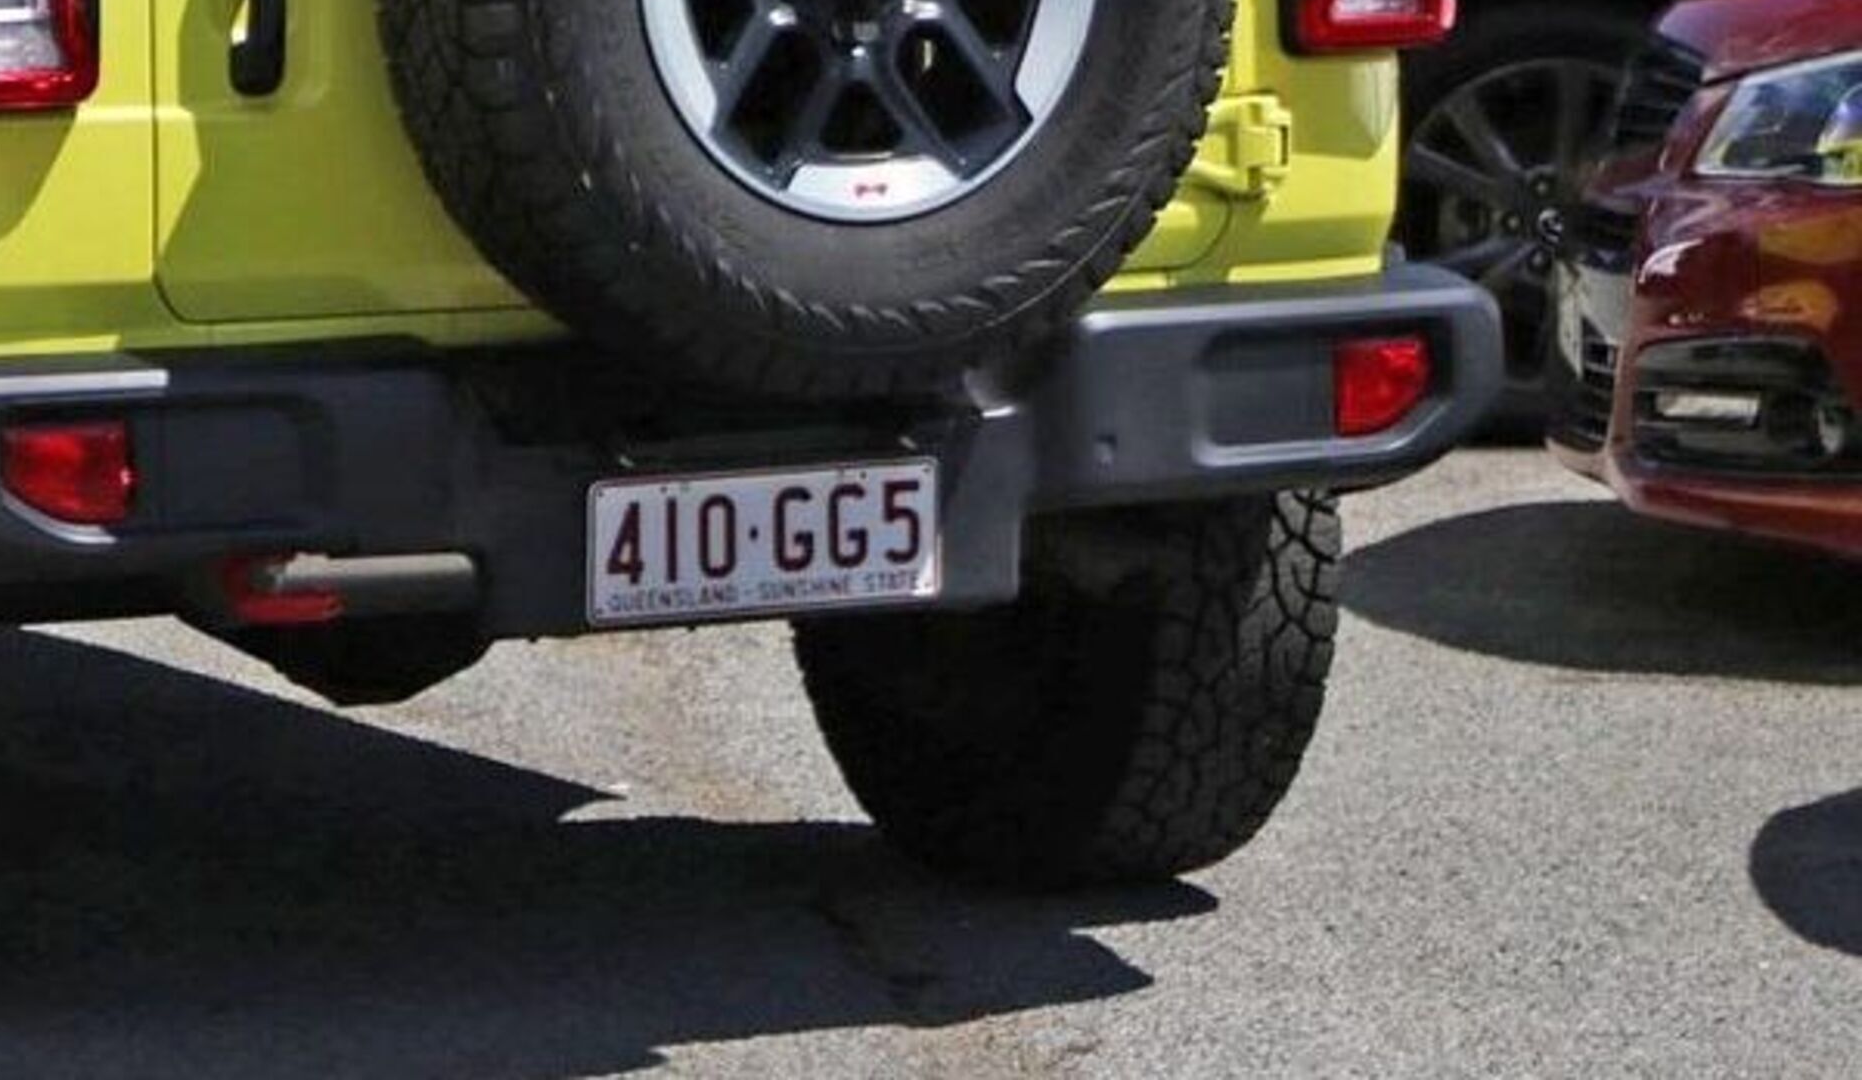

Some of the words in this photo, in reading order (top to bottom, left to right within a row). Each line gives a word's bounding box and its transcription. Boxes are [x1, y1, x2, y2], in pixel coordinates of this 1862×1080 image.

[607, 583, 739, 613] QUEENSLAND
[758, 576, 854, 602] SUNSHINE
[864, 570, 920, 594] STATE
